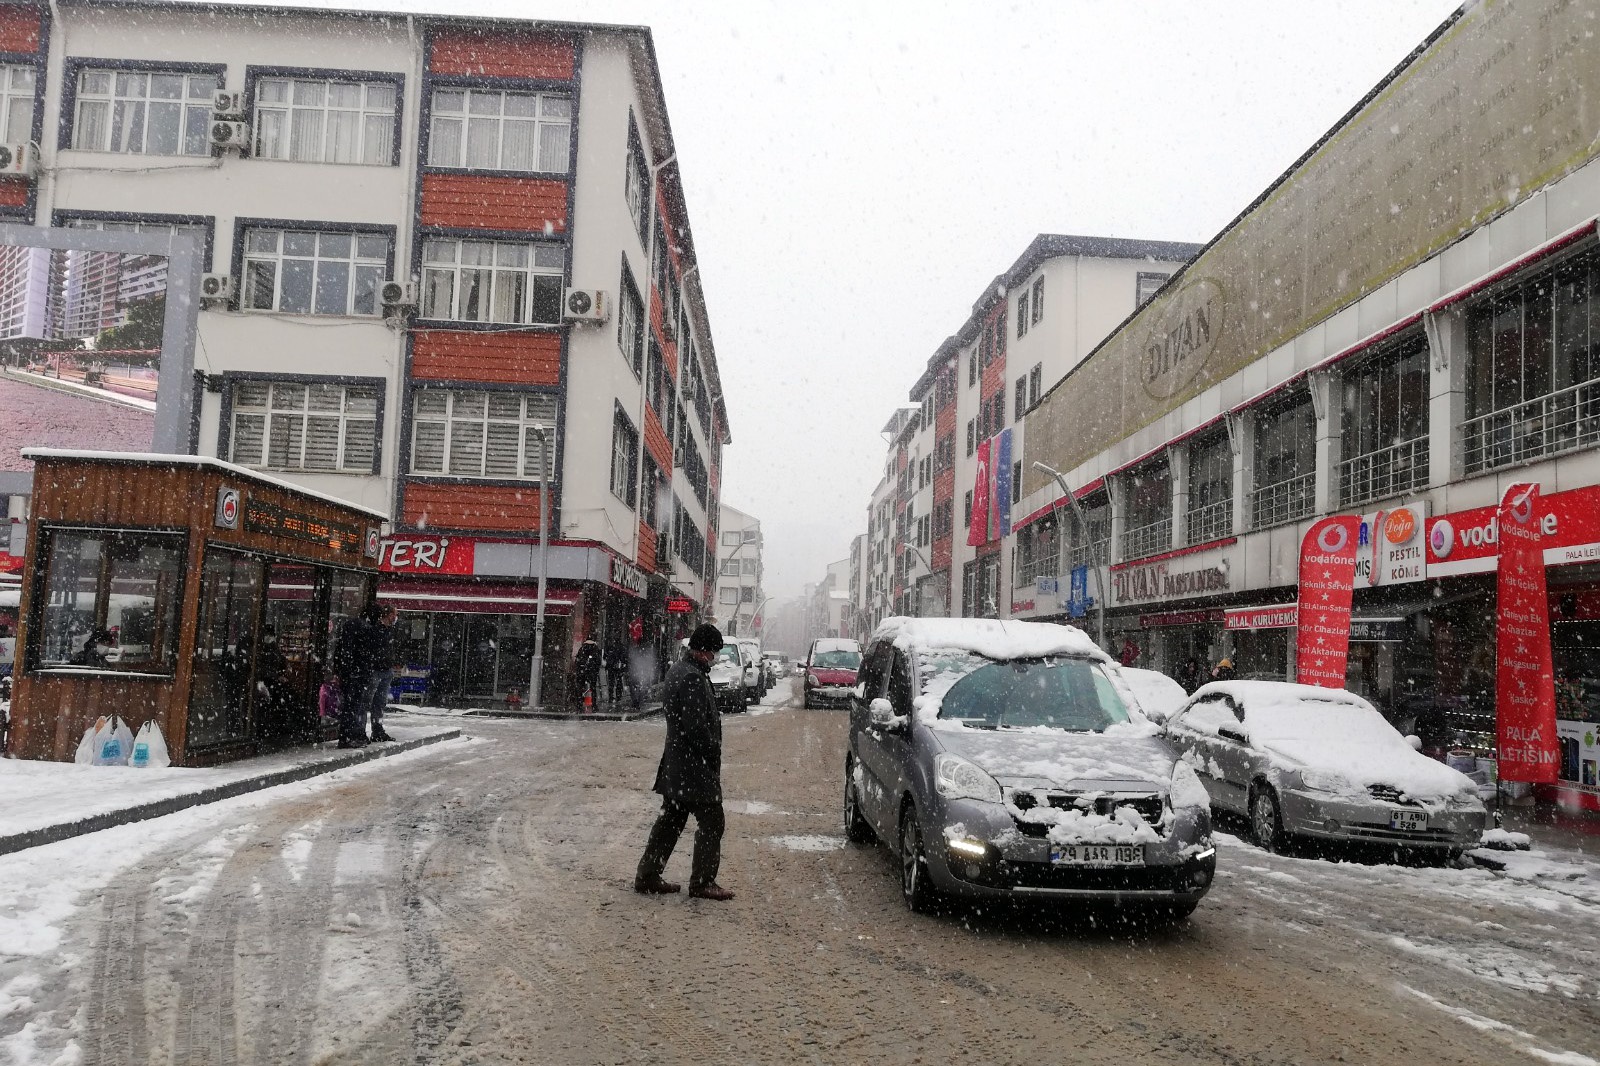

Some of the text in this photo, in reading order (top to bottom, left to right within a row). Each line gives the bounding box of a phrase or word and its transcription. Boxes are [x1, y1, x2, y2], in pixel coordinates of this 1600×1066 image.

[1386, 518, 1412, 537] Doğa
[1566, 550, 1583, 559] PALA
[1304, 555, 1355, 566] vodafone
[1391, 565, 1419, 579] KÖME
[1300, 580, 1352, 591] Teknik Servis
[1314, 625, 1347, 635] Cihazlar
[1503, 657, 1540, 671] Aksesuar
[1506, 725, 1542, 742] PALA
[1393, 812, 1404, 820] 61
[1400, 821, 1417, 829] 526
[1059, 846, 1077, 861] 29
